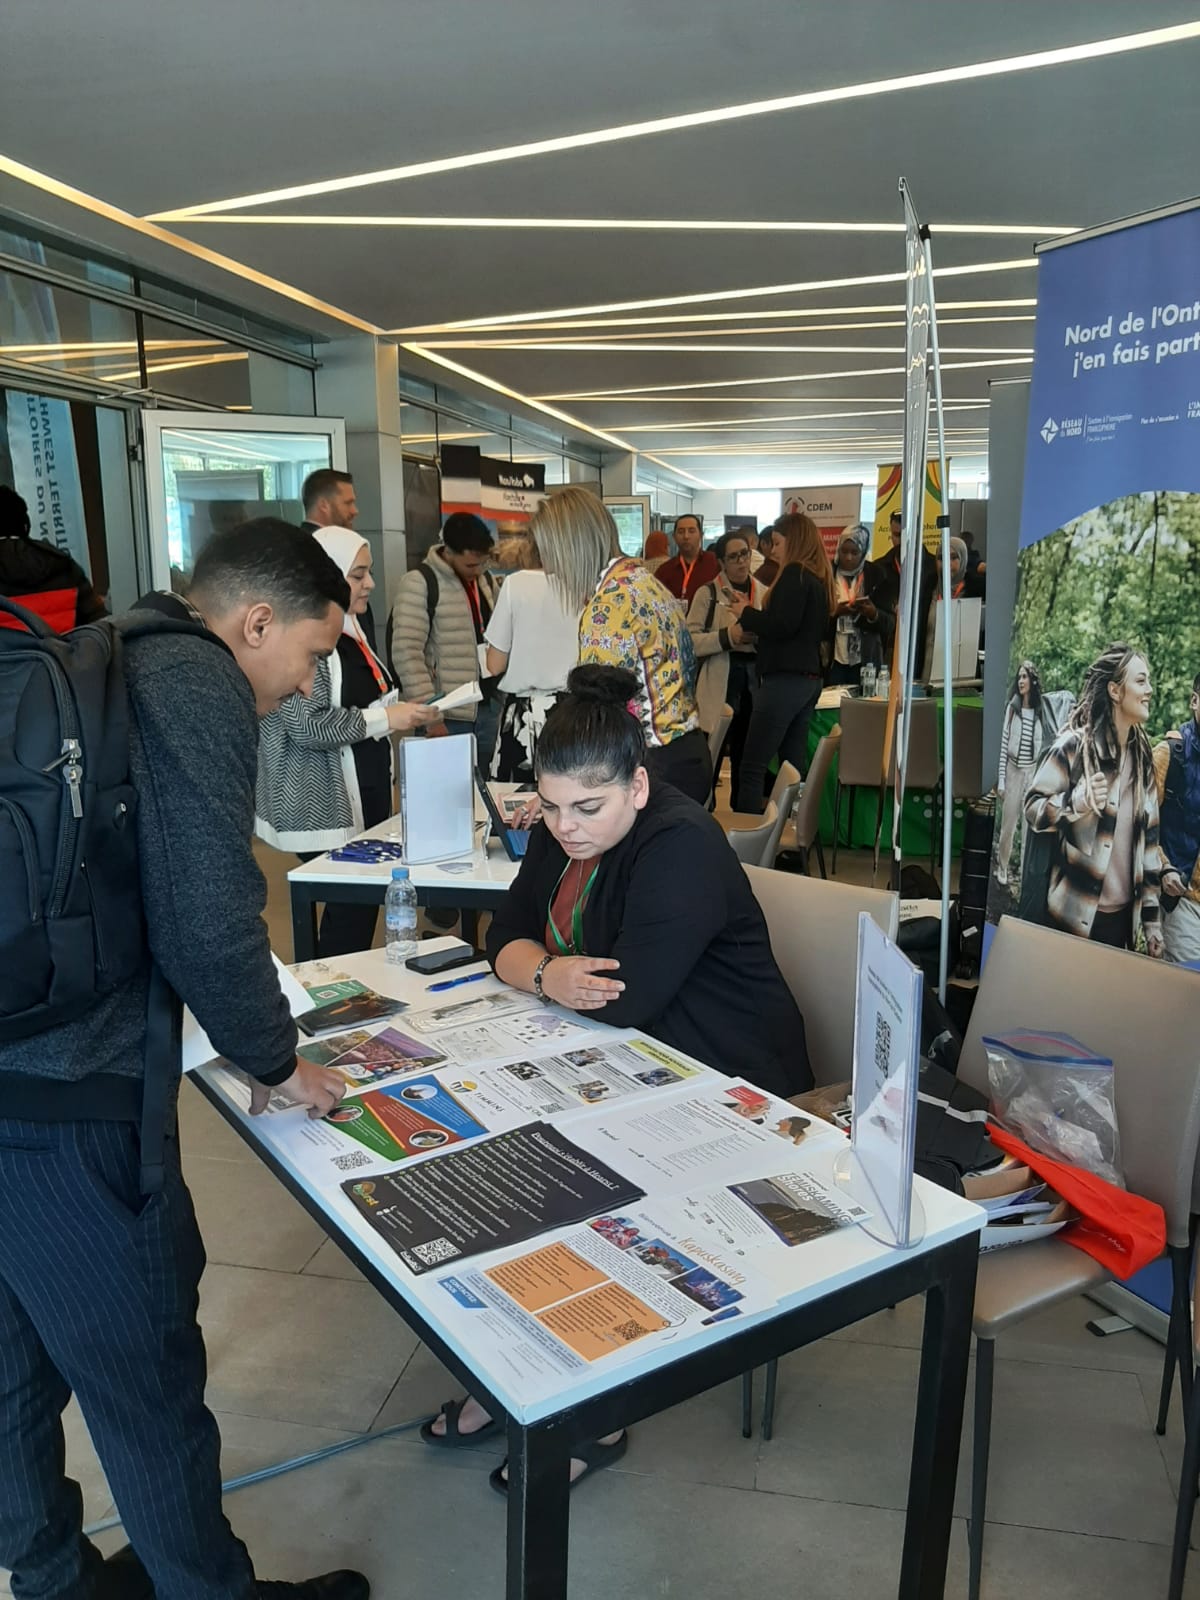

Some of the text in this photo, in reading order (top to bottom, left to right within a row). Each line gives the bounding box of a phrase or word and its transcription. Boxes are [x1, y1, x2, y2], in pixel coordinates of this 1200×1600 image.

[1065, 315, 1113, 347] Nord
[1119, 311, 1145, 335] de
[1073, 351, 1106, 378] j'en
[1112, 340, 1150, 365] fais
[1066, 426, 1082, 437] NORD
[806, 502, 833, 512] CDEM
[678, 1237, 746, 1286] Kapuskasing
